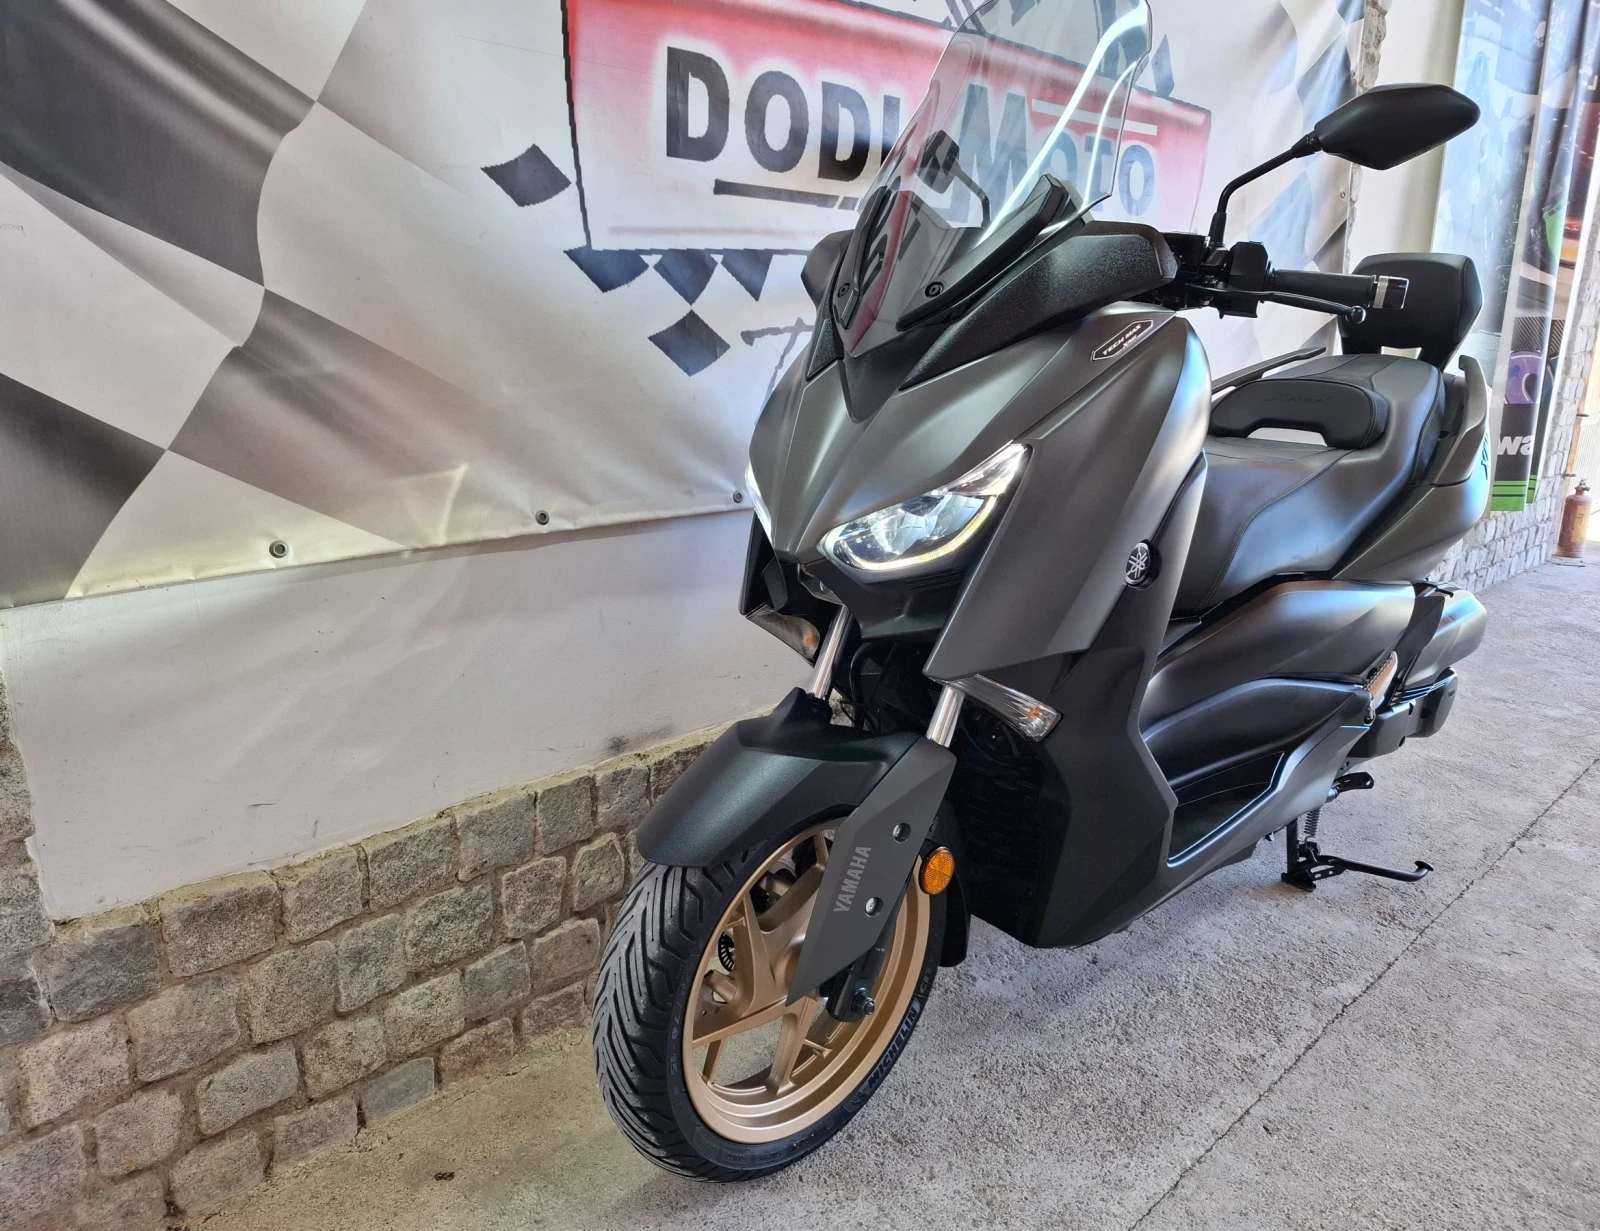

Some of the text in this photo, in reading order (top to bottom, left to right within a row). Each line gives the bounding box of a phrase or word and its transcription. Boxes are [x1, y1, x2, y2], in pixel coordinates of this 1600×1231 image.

[666, 45, 1155, 224] DODI MOTO
[1102, 336, 1125, 355] TECH
[1125, 324, 1141, 339] MAX
[833, 846, 872, 912] YAMAHA
[867, 1006, 918, 1089] MICHELIN
